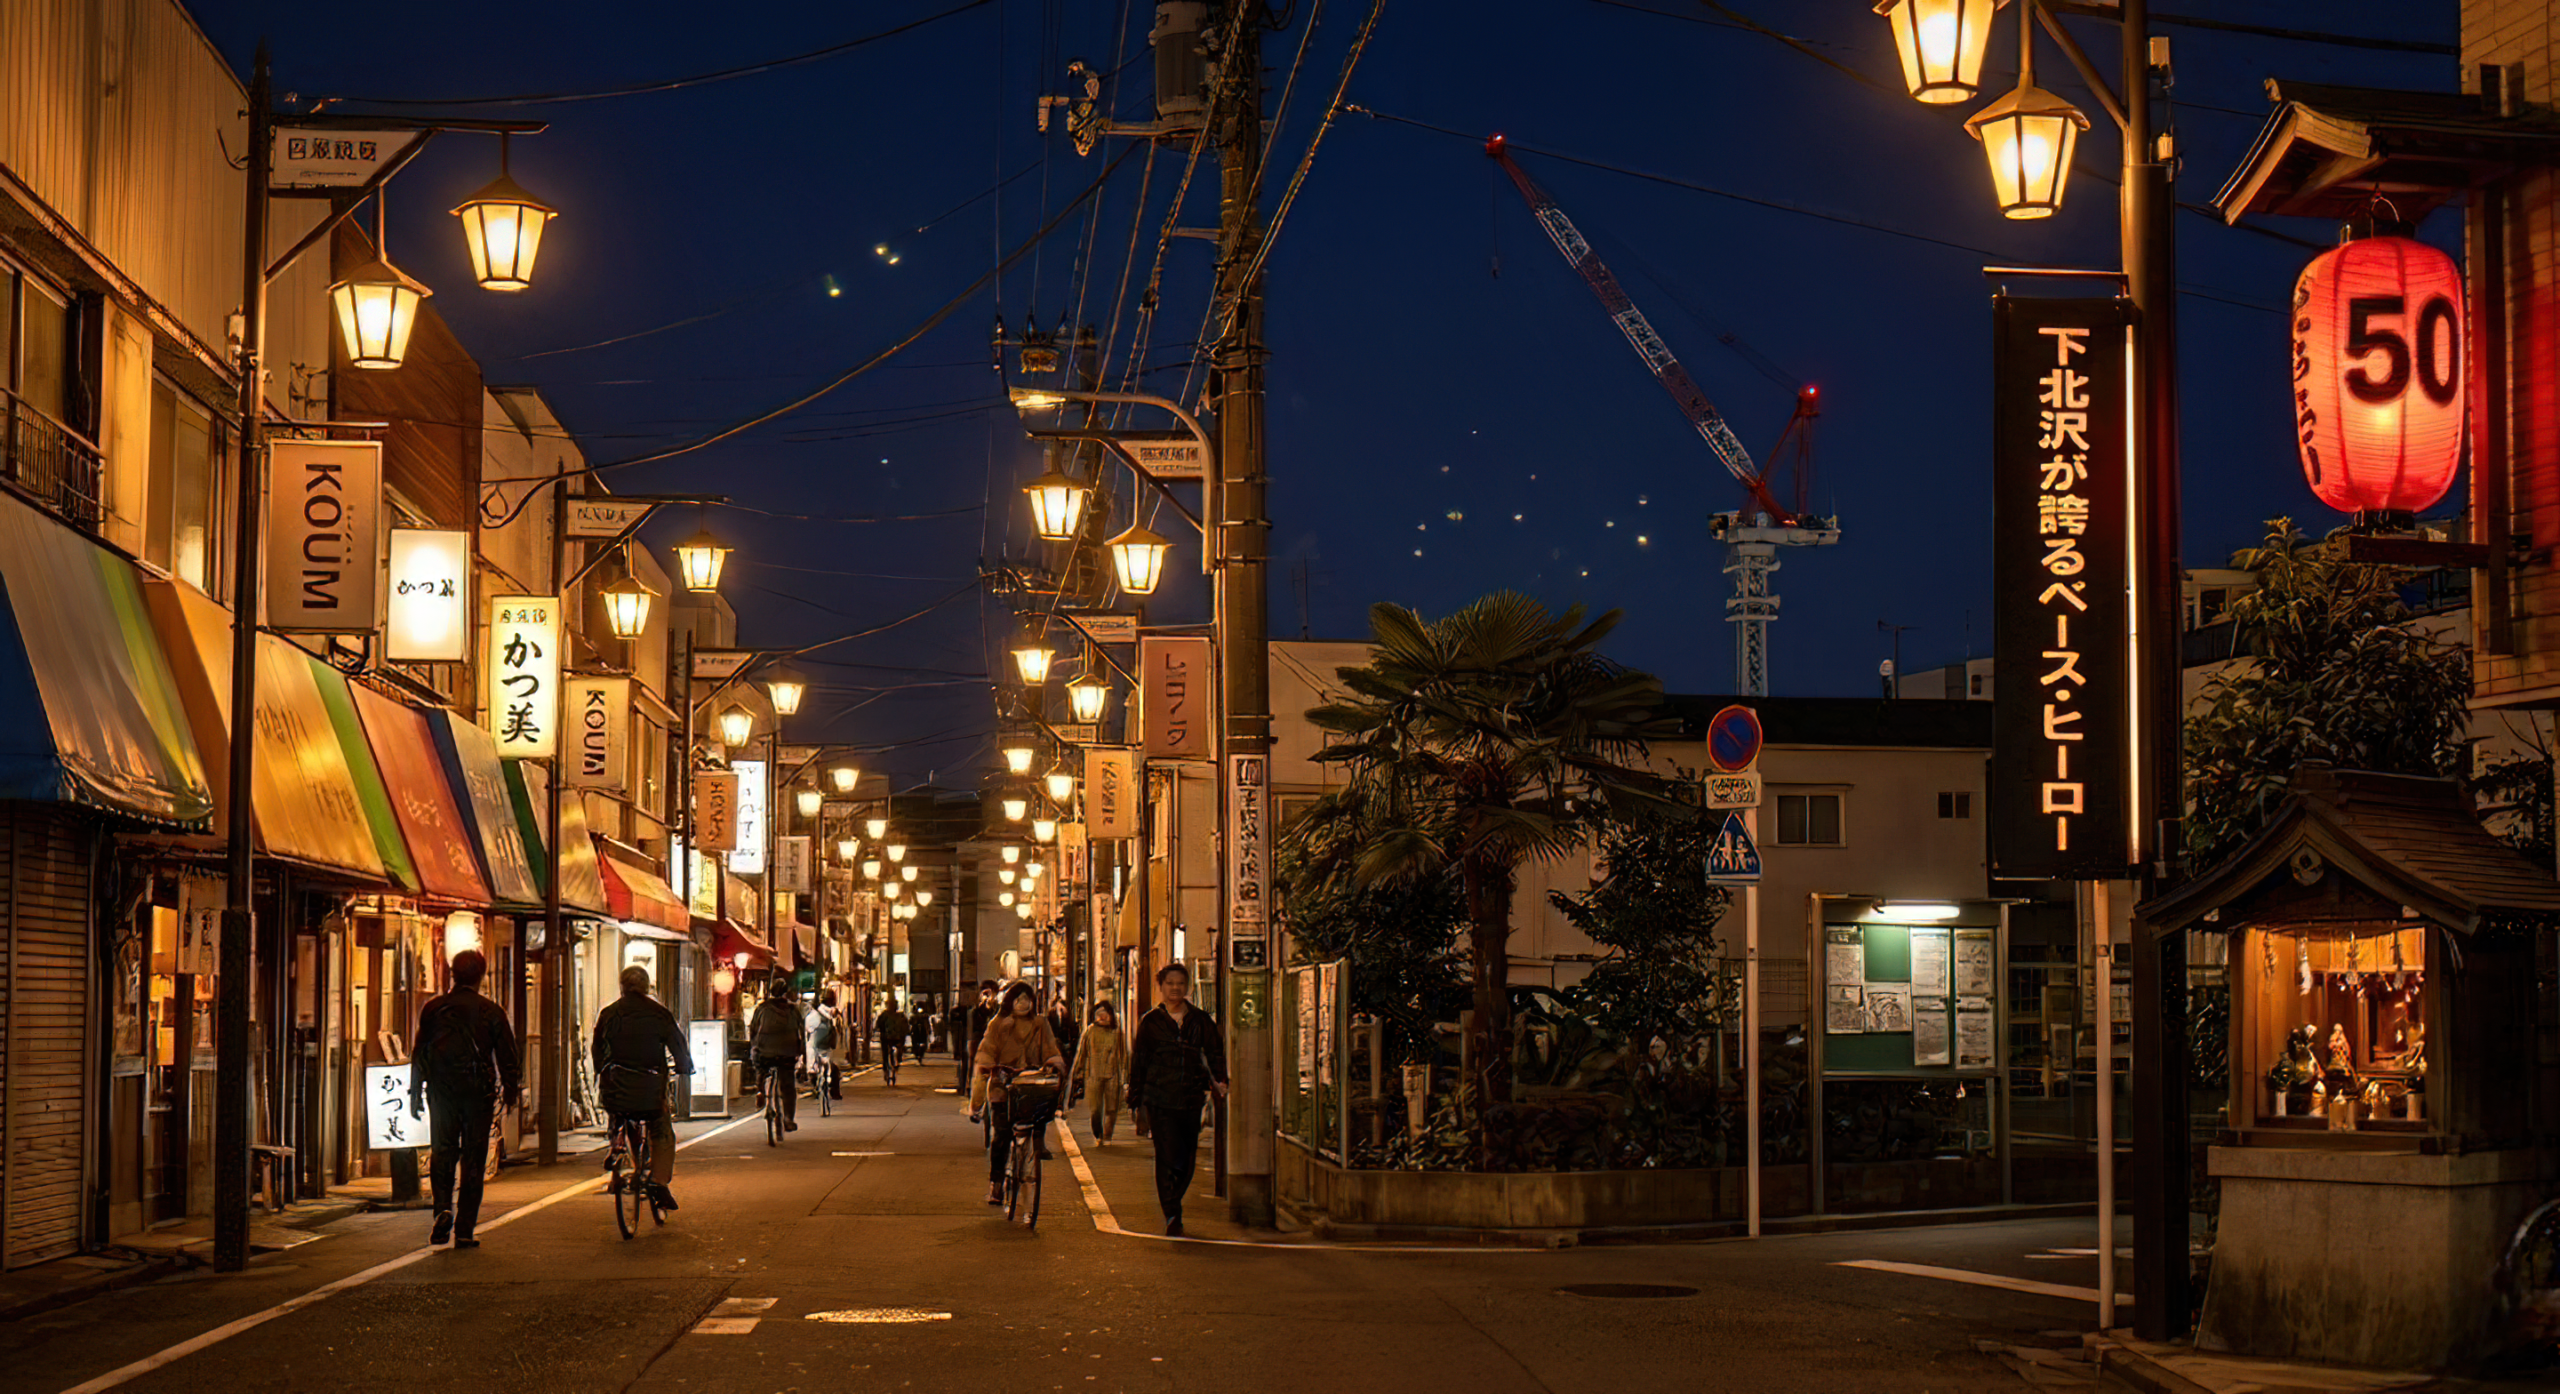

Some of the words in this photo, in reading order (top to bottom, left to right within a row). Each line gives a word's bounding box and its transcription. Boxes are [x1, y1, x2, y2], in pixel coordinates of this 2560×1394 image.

[2345, 296, 2460, 407] 50
[302, 463, 342, 610] KOUM
[2038, 327, 2090, 851] 下北沢が誇るベース・ヒーロー
[501, 632, 543, 744] かつ美
[582, 689, 606, 776] KOUM
